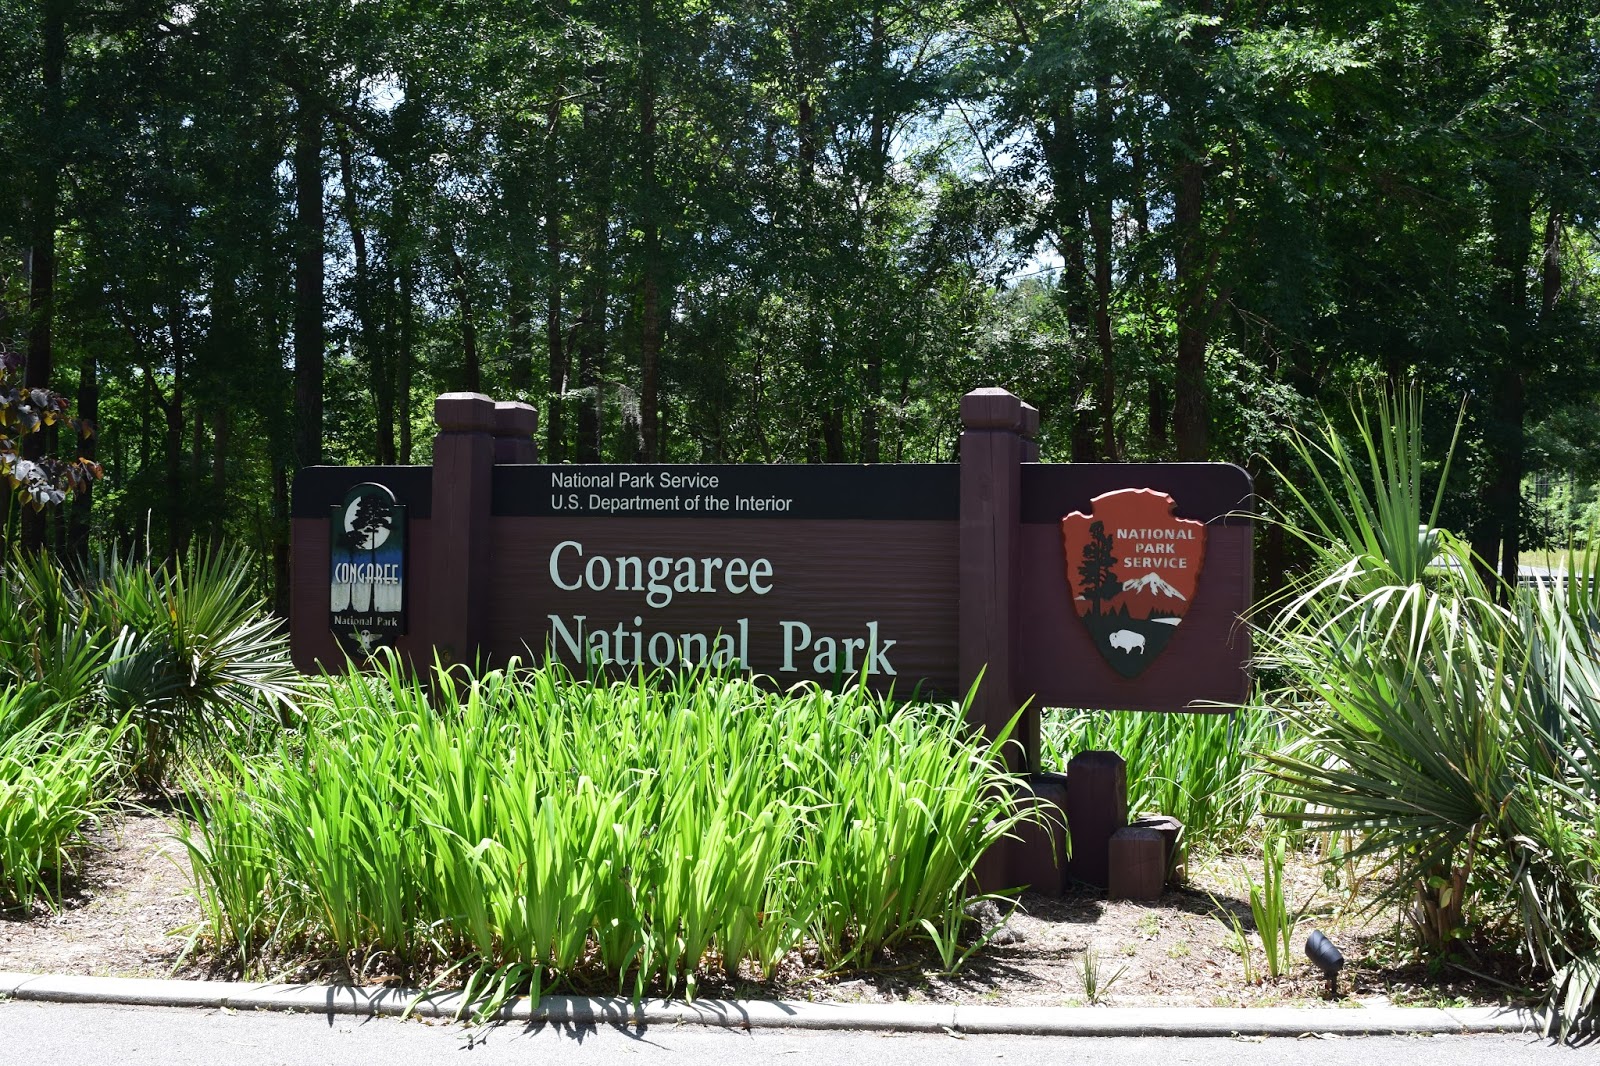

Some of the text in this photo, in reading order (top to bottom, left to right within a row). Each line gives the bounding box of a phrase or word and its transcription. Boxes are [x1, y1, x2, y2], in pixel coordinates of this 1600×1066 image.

[551, 472, 719, 489] National Park Service
[551, 494, 793, 513] U.S. Department of the Interior
[1117, 528, 1196, 540] NATIONAL
[1135, 543, 1176, 554] PARK
[1123, 557, 1187, 569] SERVICE
[335, 562, 399, 585] CONGAREE
[549, 540, 774, 608] Congaree
[334, 615, 398, 627] National Park
[547, 614, 897, 676] National Park
